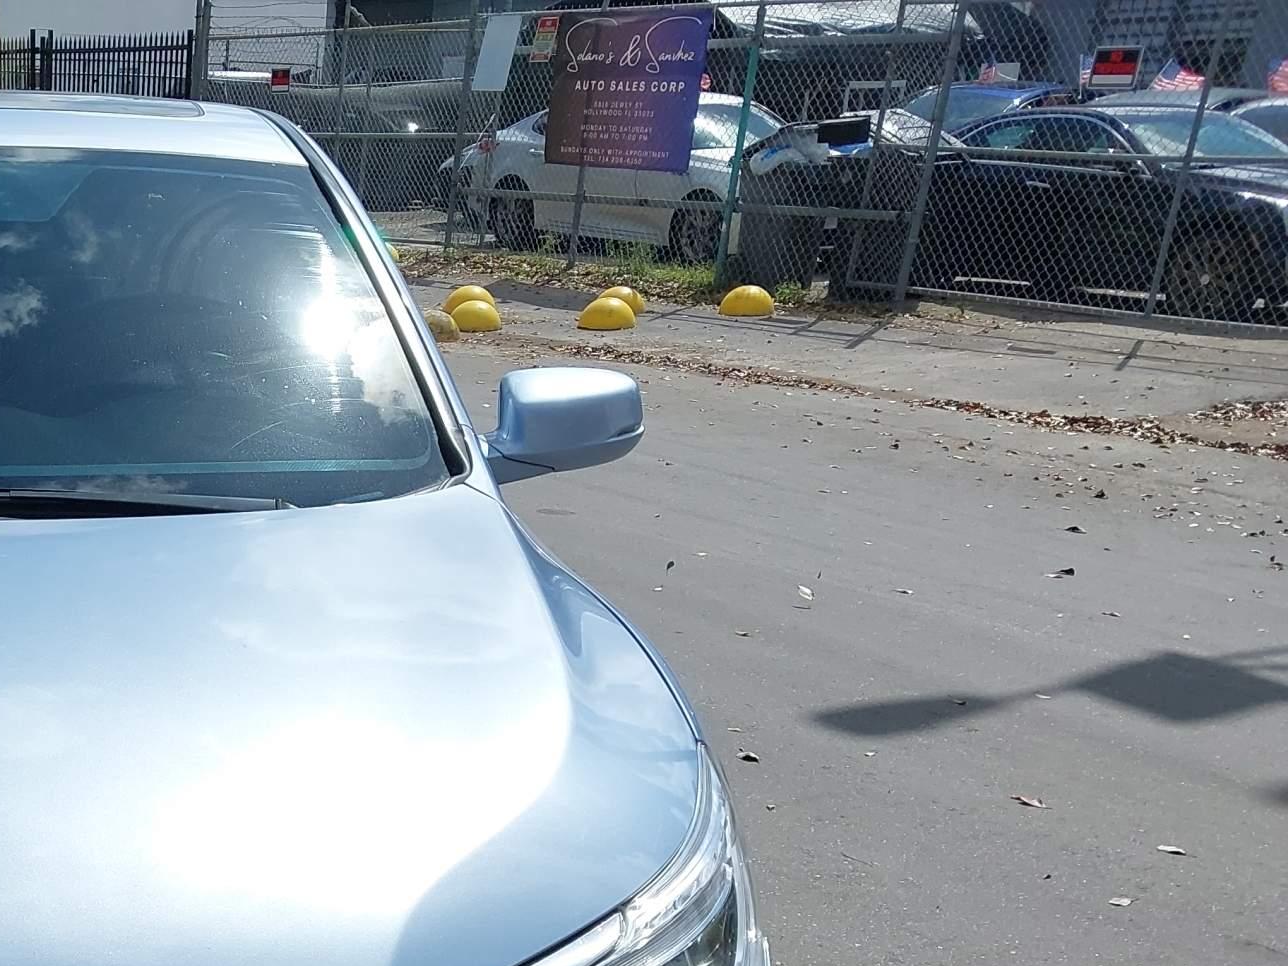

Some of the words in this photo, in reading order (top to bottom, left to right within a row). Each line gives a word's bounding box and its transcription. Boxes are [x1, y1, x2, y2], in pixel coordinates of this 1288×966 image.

[619, 35, 641, 67] &
[575, 80, 605, 91] AUTO
[610, 81, 646, 92] SALES
[651, 81, 686, 93] CORP
[583, 108, 622, 117] HOLLYWOOD
[580, 124, 606, 132] MONDAY
[619, 125, 653, 134] SATURDAY
[588, 147, 605, 155] ONLY
[607, 148, 623, 156] WITH
[625, 149, 669, 158] APPOINTMENT
